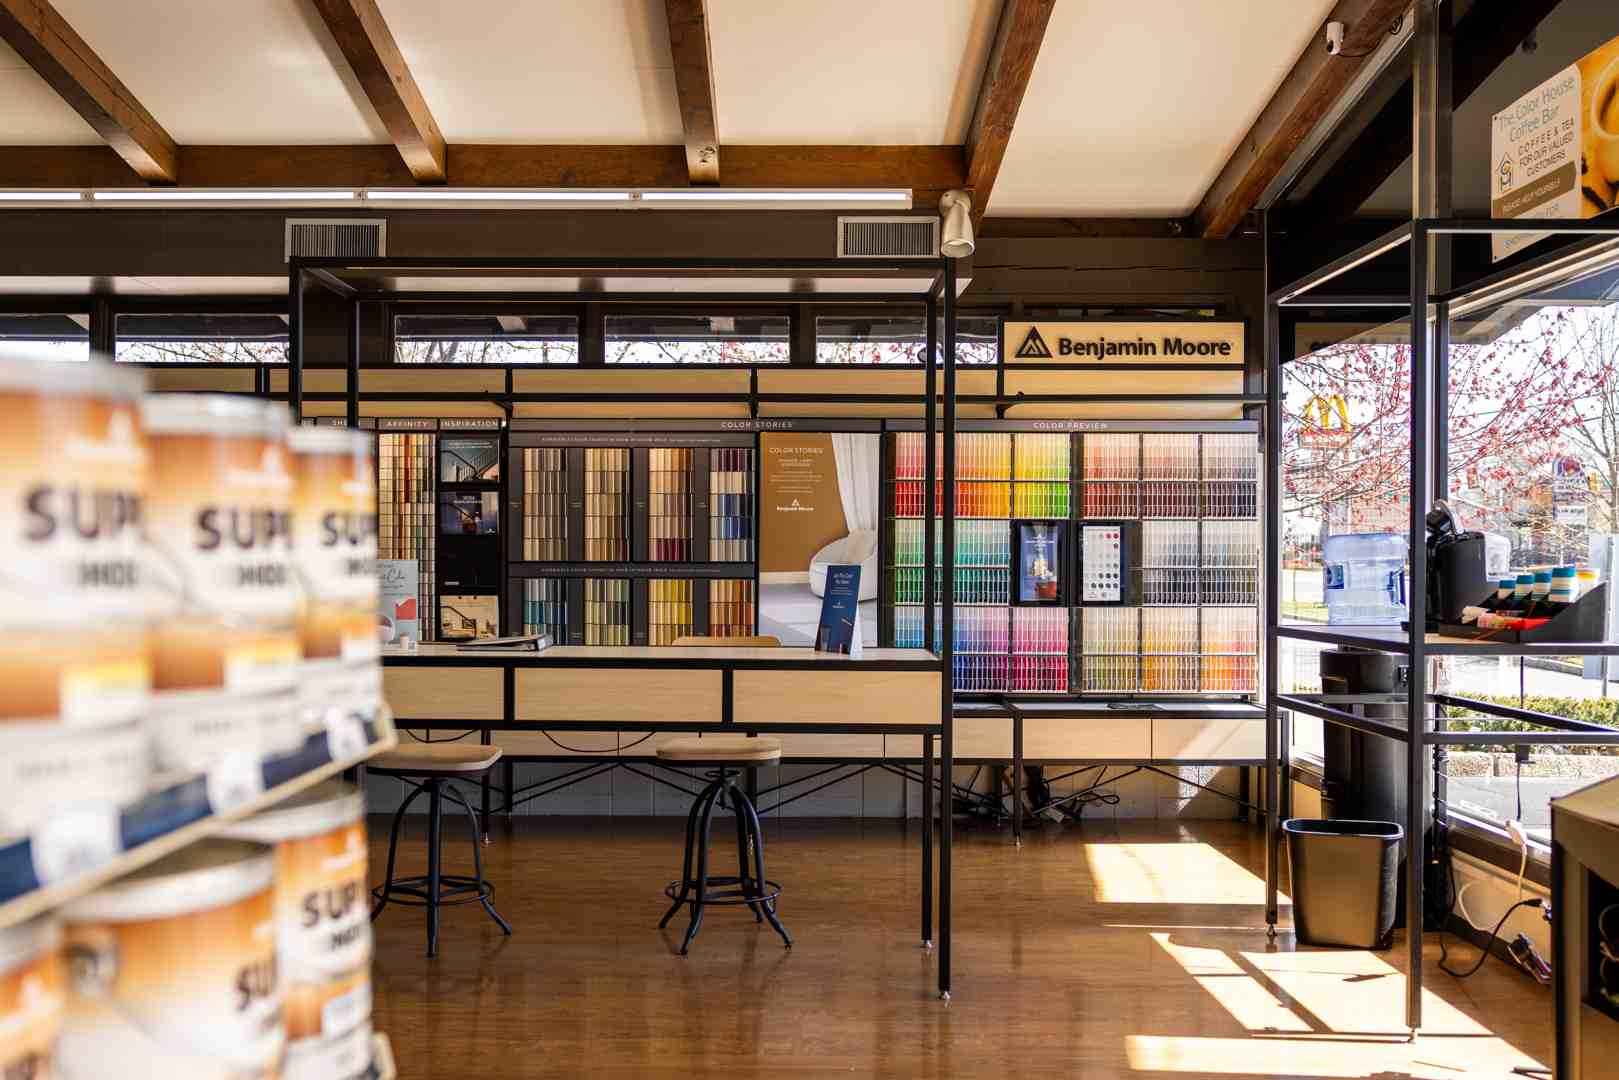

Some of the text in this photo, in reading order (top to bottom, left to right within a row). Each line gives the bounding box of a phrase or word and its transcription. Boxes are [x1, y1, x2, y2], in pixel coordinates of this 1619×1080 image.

[1498, 75, 1575, 130] The Color House
[1509, 104, 1560, 143] Coffee Bar
[1518, 127, 1553, 156] COFFEE
[1561, 117, 1575, 134] TEA
[1519, 130, 1575, 168] FOR OUR VALUED
[1526, 149, 1566, 178] CUSTOMERS
[1058, 337, 1232, 361] Benjamin Moore
[384, 420, 427, 428] AFFINITY
[721, 421, 793, 429] COLOR STORIES
